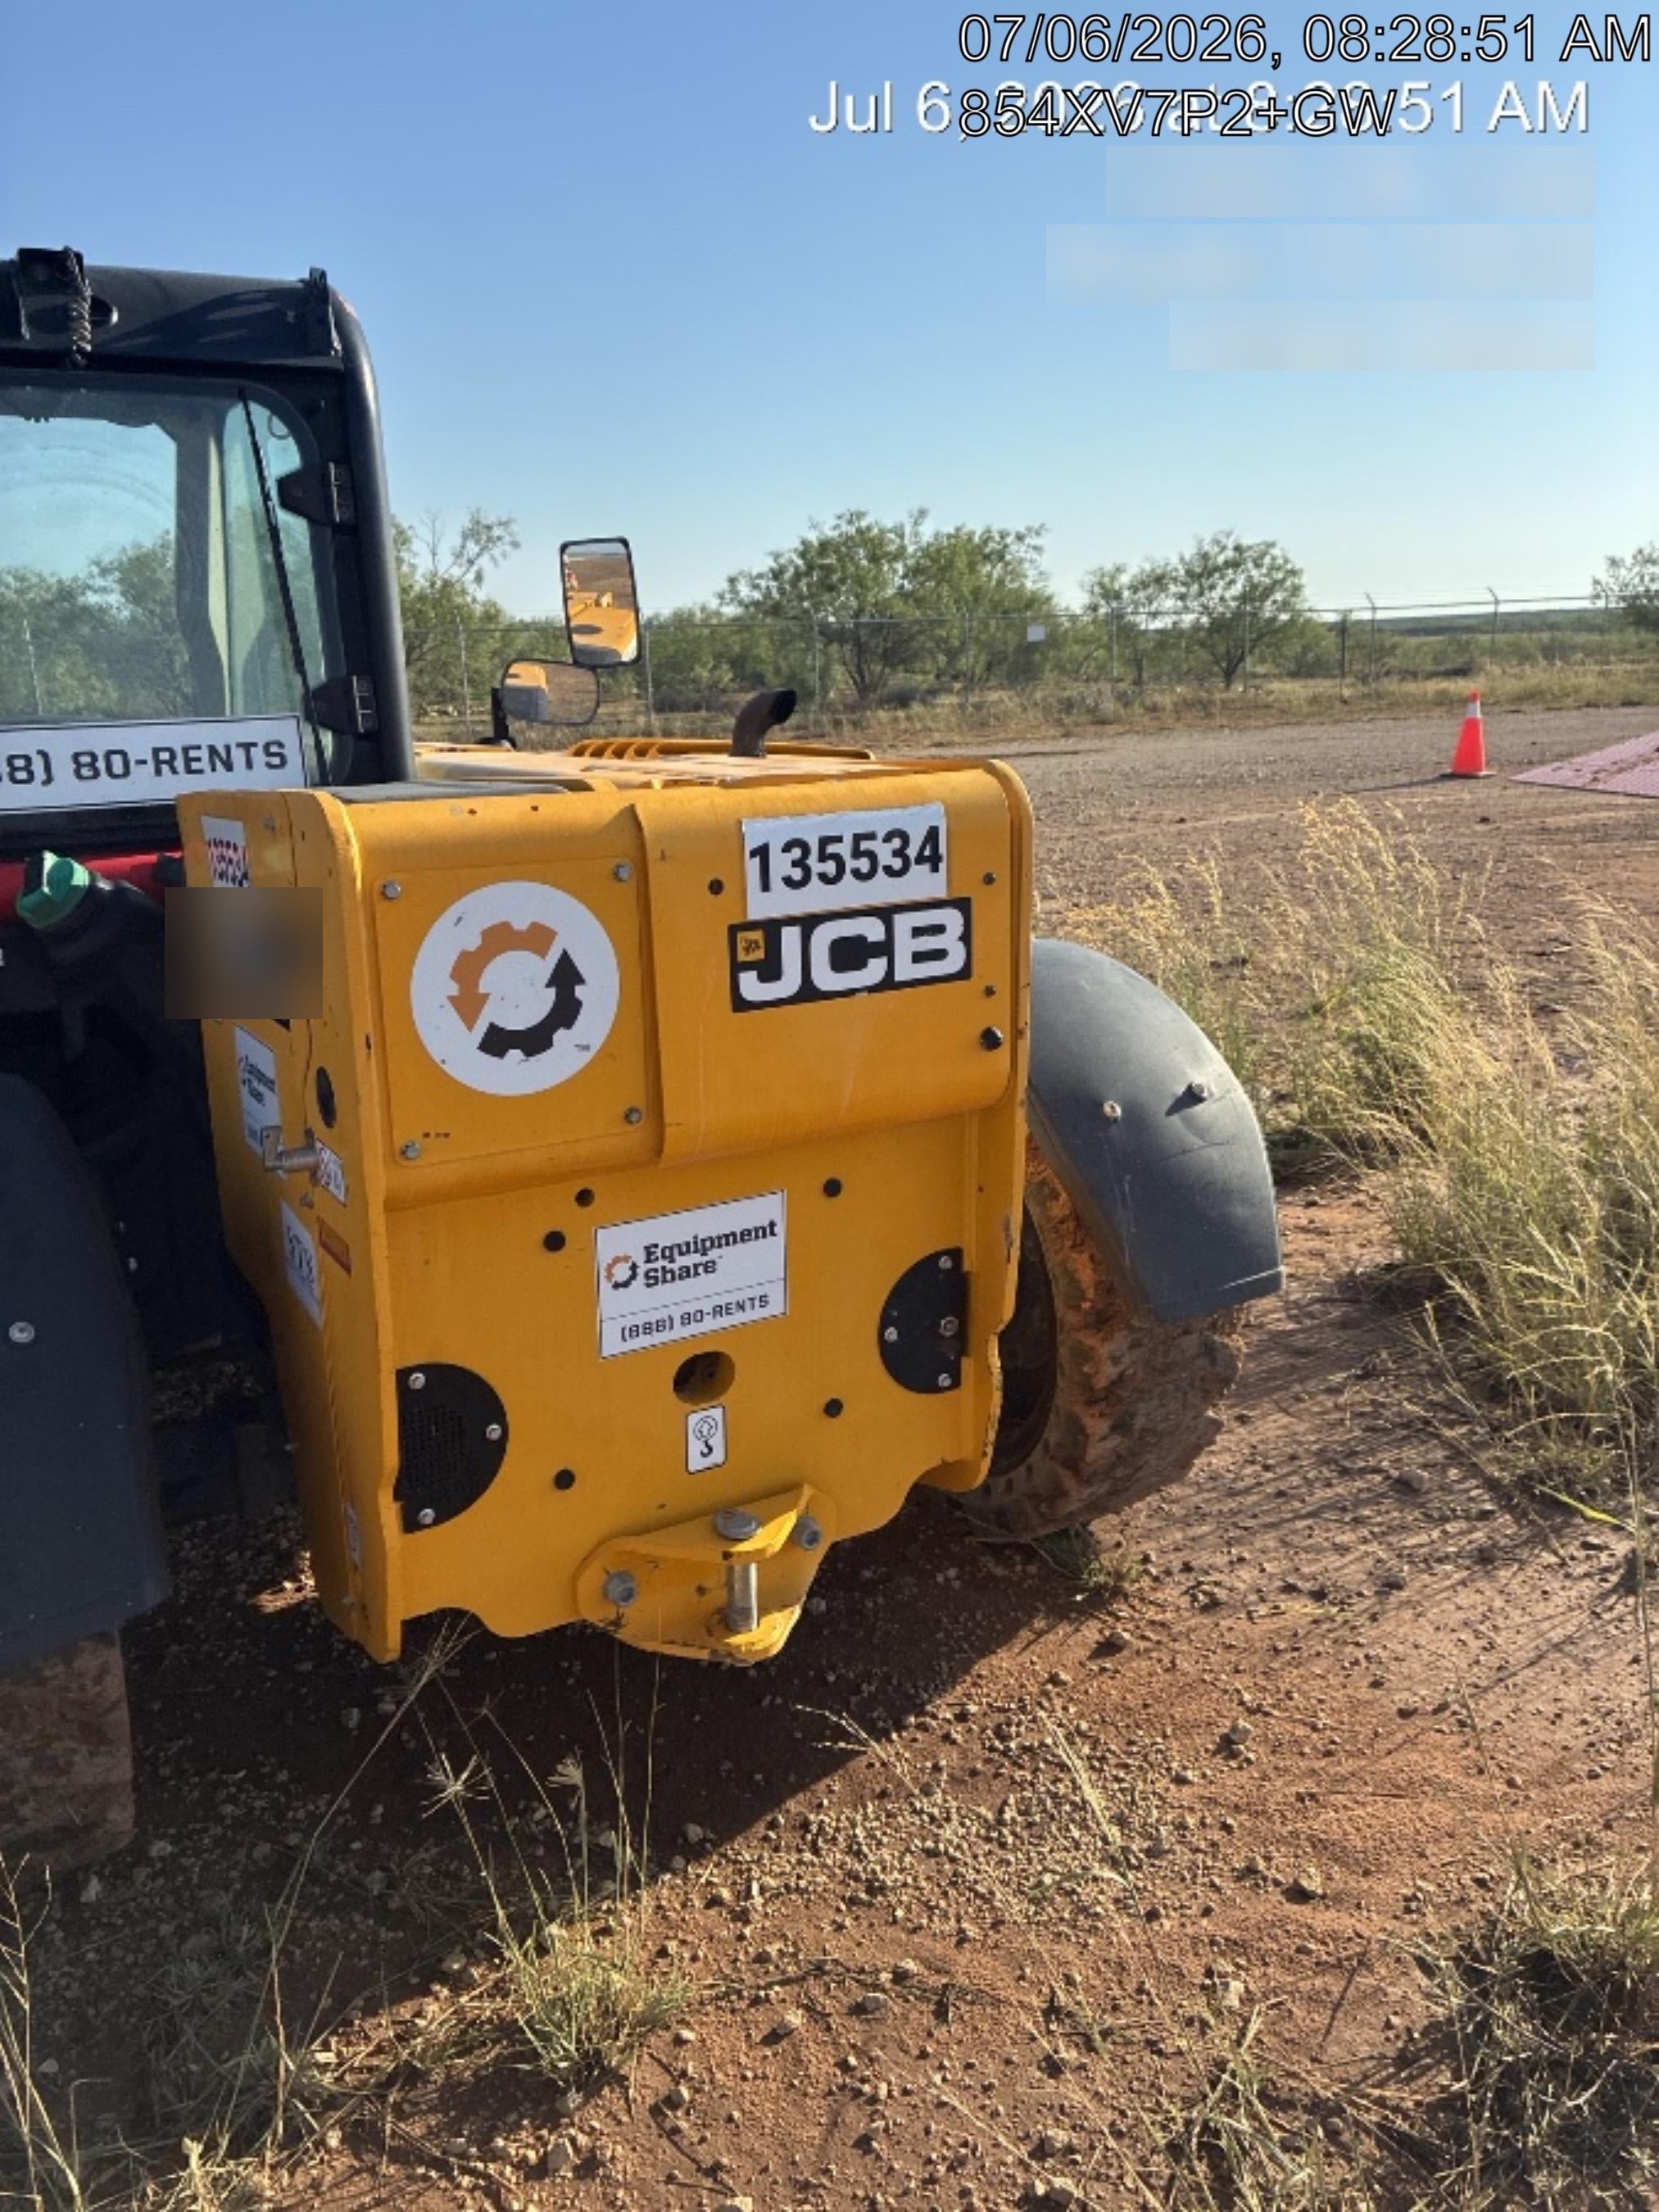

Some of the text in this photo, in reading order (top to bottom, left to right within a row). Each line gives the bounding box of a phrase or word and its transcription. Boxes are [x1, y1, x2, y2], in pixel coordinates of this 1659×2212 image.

[0, 741, 288, 786] 8) 80-RENTS
[750, 825, 943, 892] 135534
[738, 907, 967, 1003] JCB
[643, 1219, 777, 1263] Equipment
[643, 1259, 717, 1288] Share
[621, 1294, 769, 1342] (888) 80-RENTS
